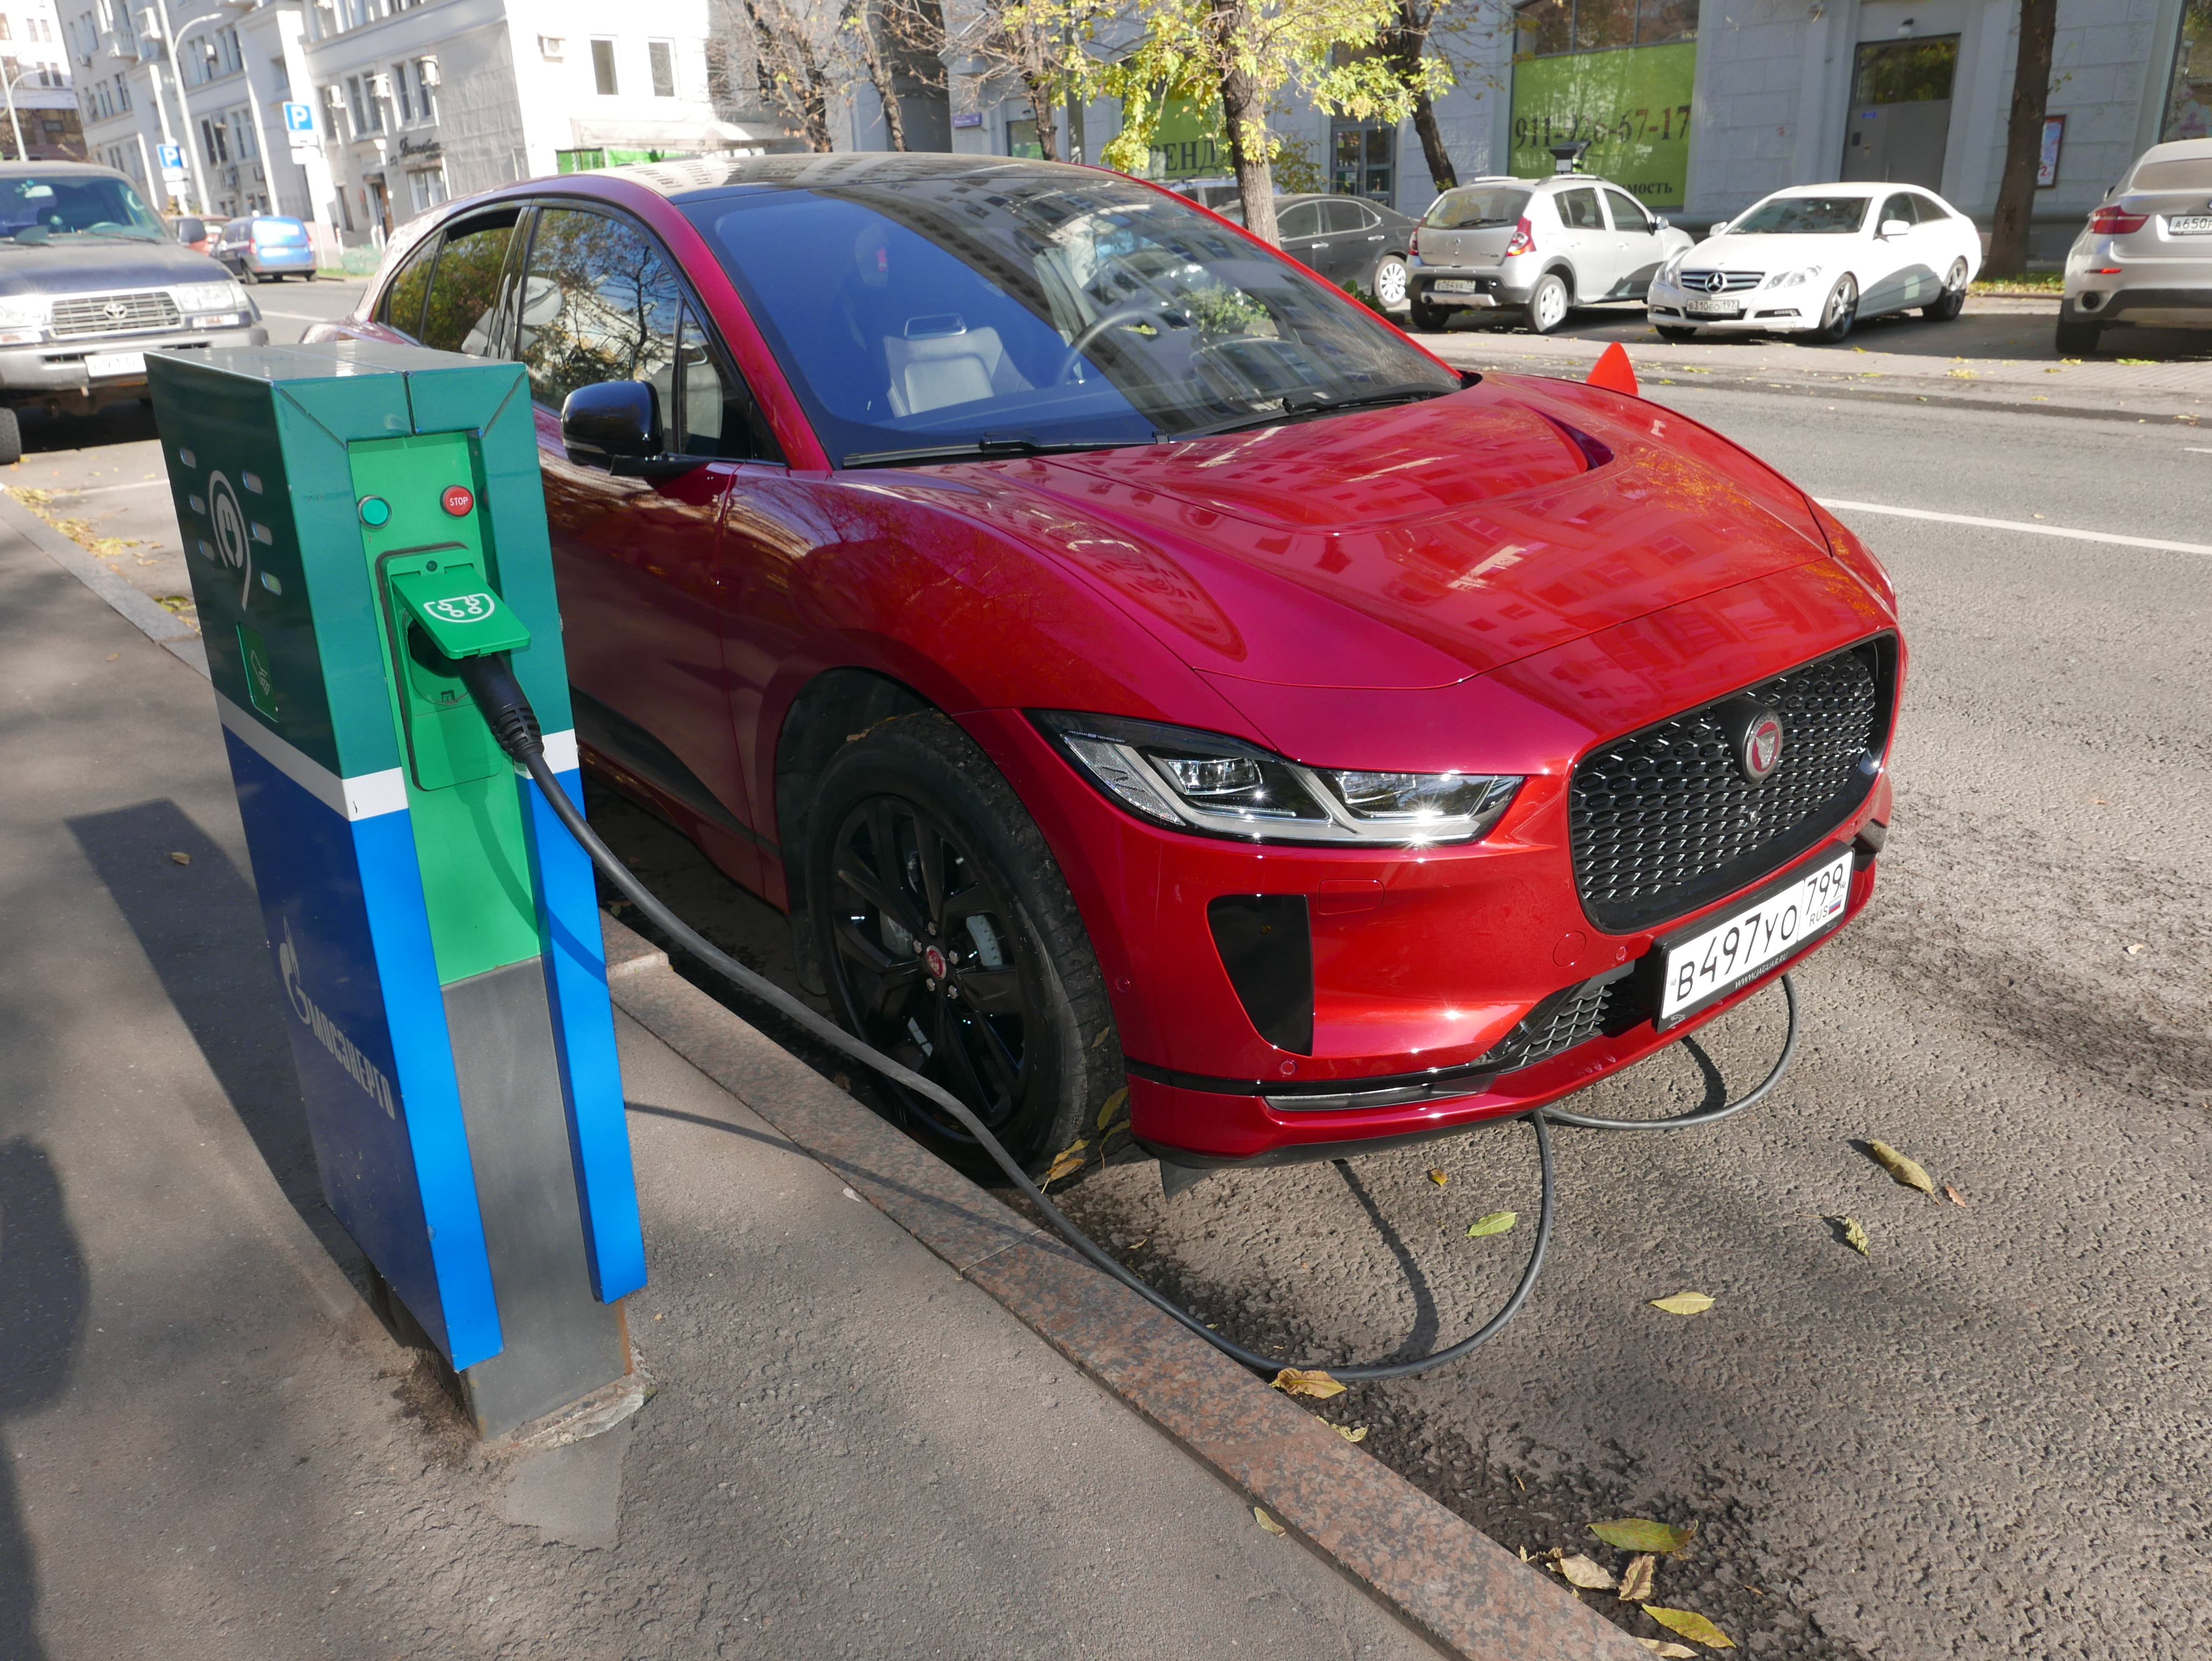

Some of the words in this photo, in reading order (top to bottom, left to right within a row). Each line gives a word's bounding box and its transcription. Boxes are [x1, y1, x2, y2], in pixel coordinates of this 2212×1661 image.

[449, 496, 469, 507] STOP
[1097, 735, 1125, 743] TECHNOLOGY
[1806, 863, 1844, 916] 799
[1809, 905, 1828, 927] RUS
